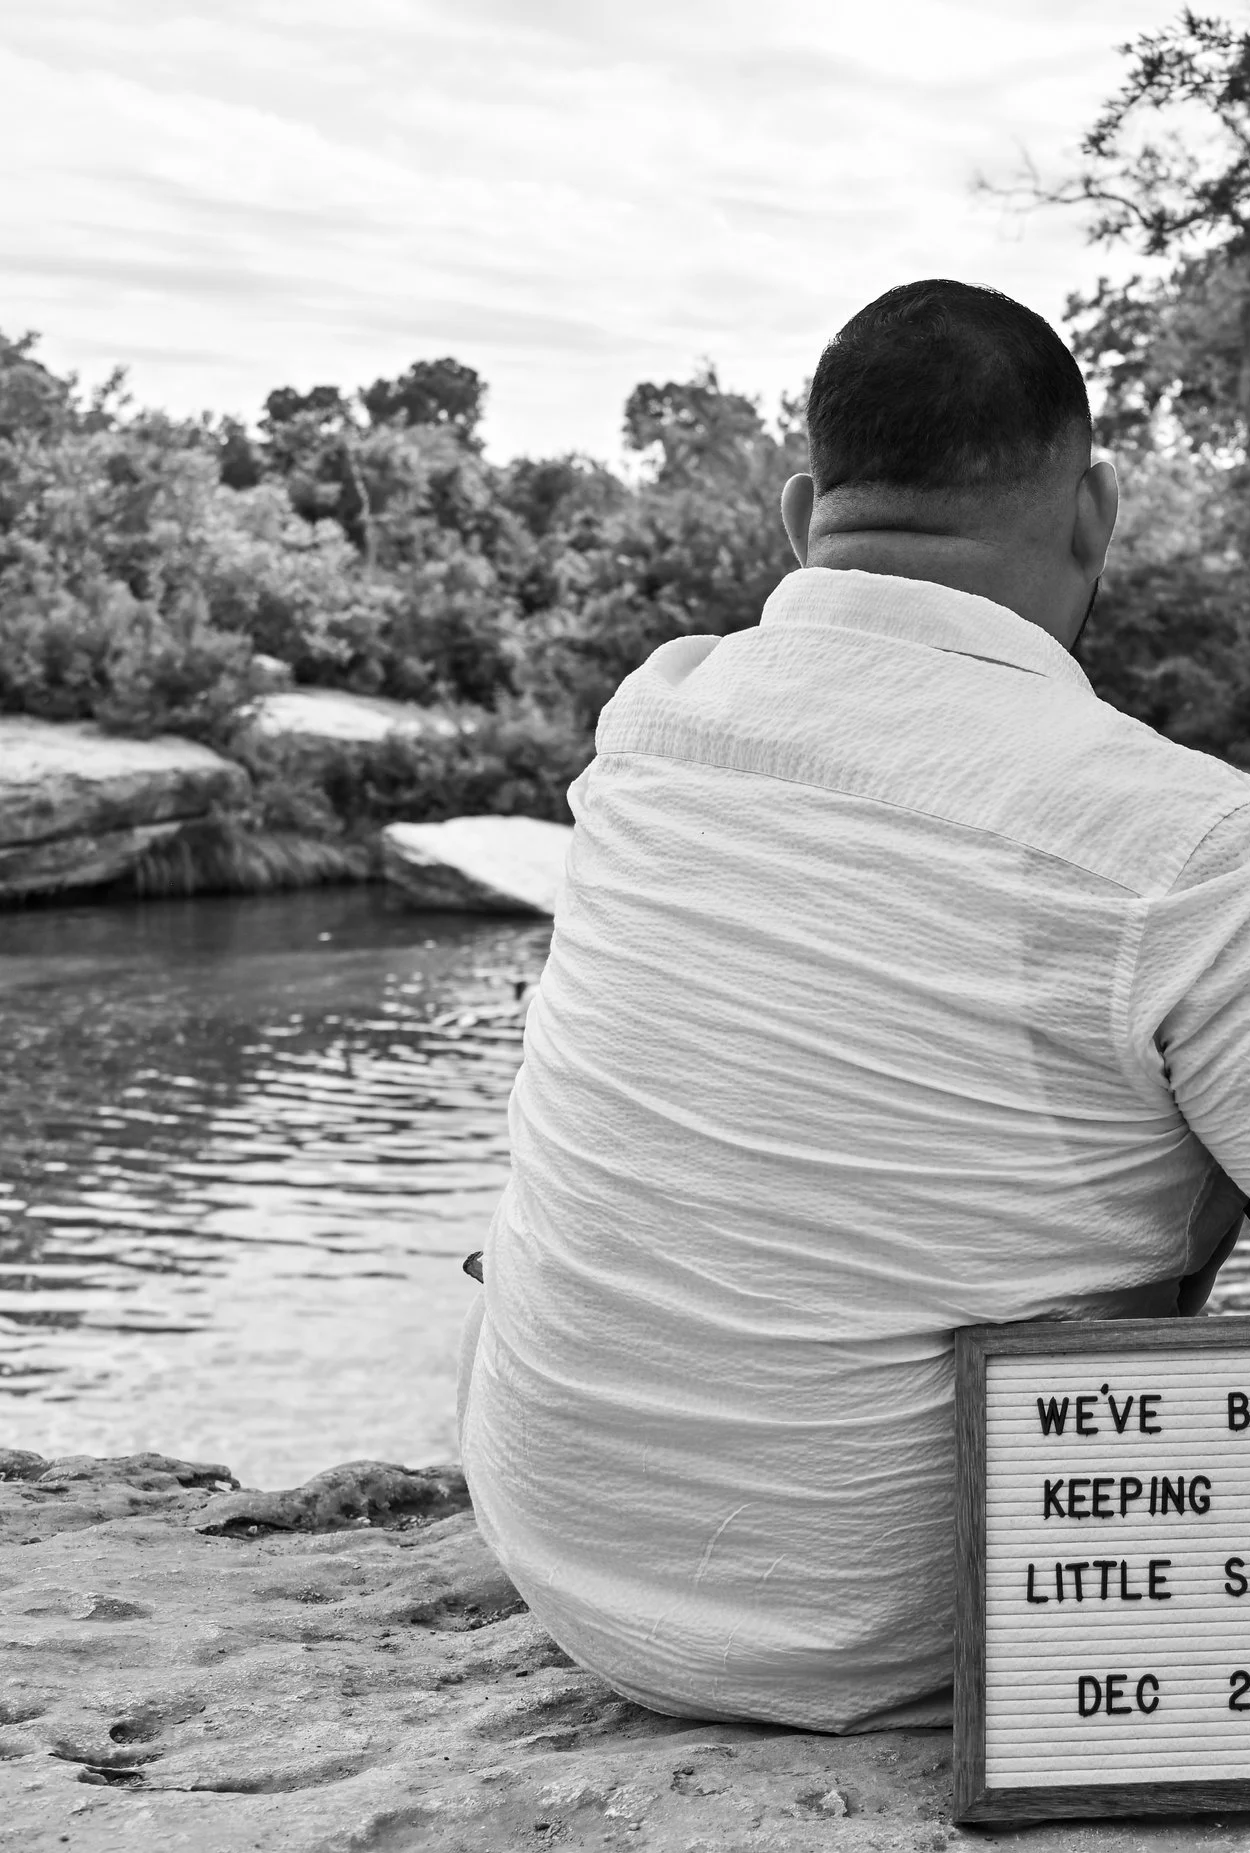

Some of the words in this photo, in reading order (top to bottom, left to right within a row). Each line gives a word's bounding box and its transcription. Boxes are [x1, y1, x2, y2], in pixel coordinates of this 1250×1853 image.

[1037, 1383, 1163, 1436] WE'VE
[1041, 1475, 1212, 1520] KEEPING
[1026, 1559, 1173, 1604] LITTLE
[1078, 1673, 1160, 1718] DEC
